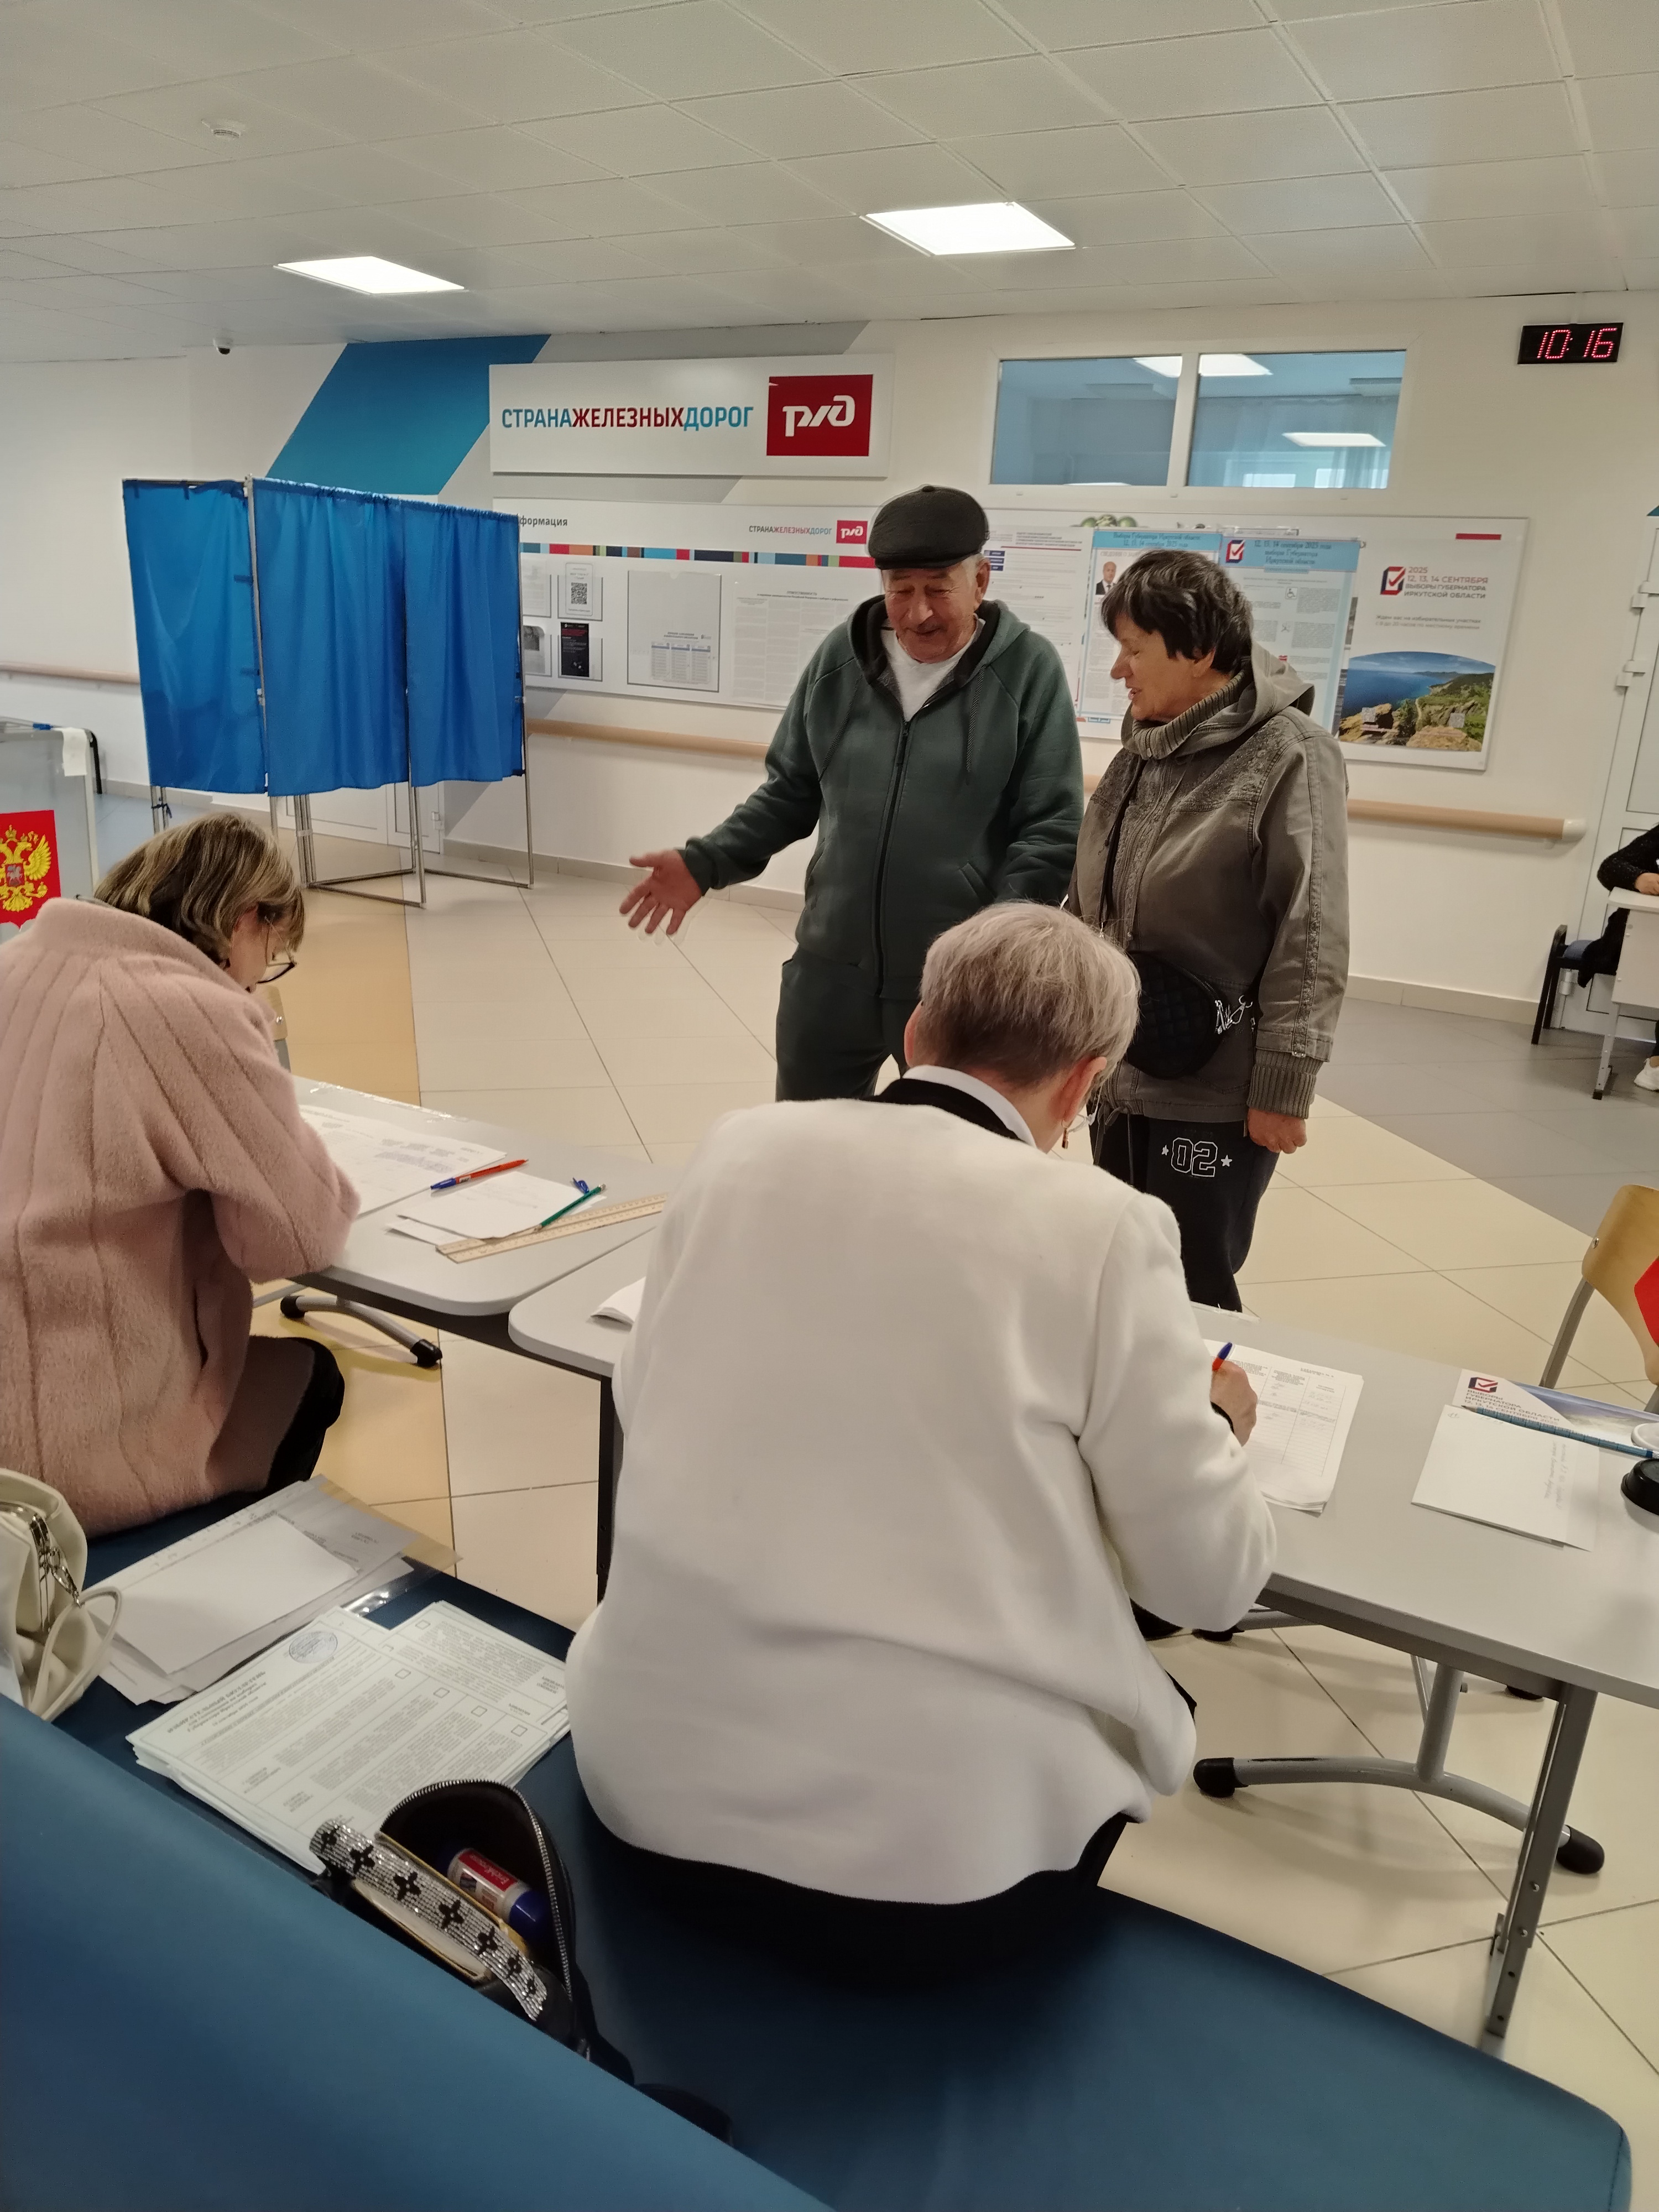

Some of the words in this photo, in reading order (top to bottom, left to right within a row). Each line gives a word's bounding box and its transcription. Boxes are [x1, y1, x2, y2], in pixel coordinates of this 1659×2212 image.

[1537, 327, 1618, 359] 10:16
[520, 515, 568, 528] формация
[1171, 1137, 1218, 1177] 02
[1466, 1393, 1521, 1408] ГУБЕРНАТОРА
[1467, 1389, 1503, 1400] ВЫБОРЫ
[1465, 1396, 1516, 1411] ИРКУТСКОЙ
[1519, 1409, 1559, 1421] ОБЛАСТИ
[1495, 1407, 1538, 1420] СЕНТЯБРЯ
